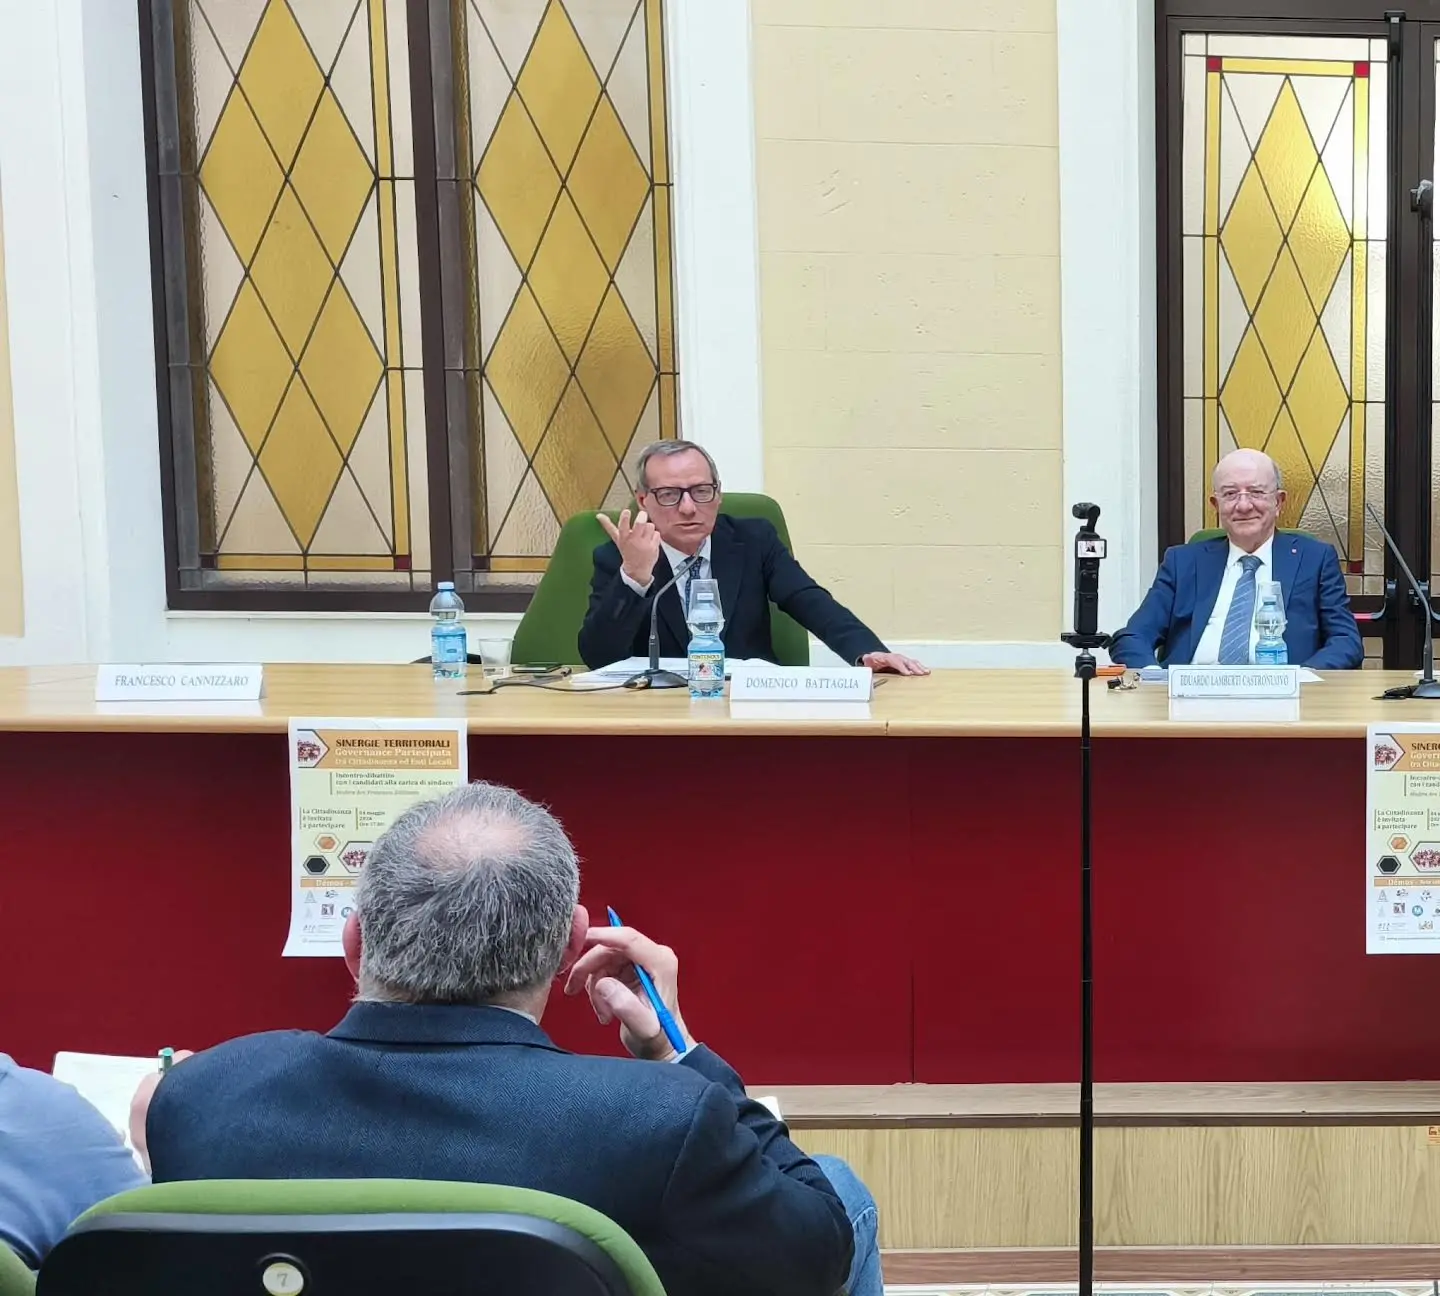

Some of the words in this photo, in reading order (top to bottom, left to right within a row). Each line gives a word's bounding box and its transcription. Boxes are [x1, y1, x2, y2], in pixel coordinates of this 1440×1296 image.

[115, 675, 176, 686] FRANCESCO
[181, 675, 249, 686] CANNIZZARO
[746, 677, 798, 689] DOMENICO
[805, 677, 859, 689] BATTAGLIA
[1180, 674, 1209, 686] EDUARDO
[1211, 674, 1241, 686] LAMBERTI
[1242, 674, 1289, 686] CASTRONUOVO
[335, 739, 380, 748] SINERGIE
[384, 739, 450, 748] TERRITORIALI
[335, 748, 393, 757] Governance
[394, 748, 452, 758] Partecipata
[276, 1272, 288, 1288] 7
